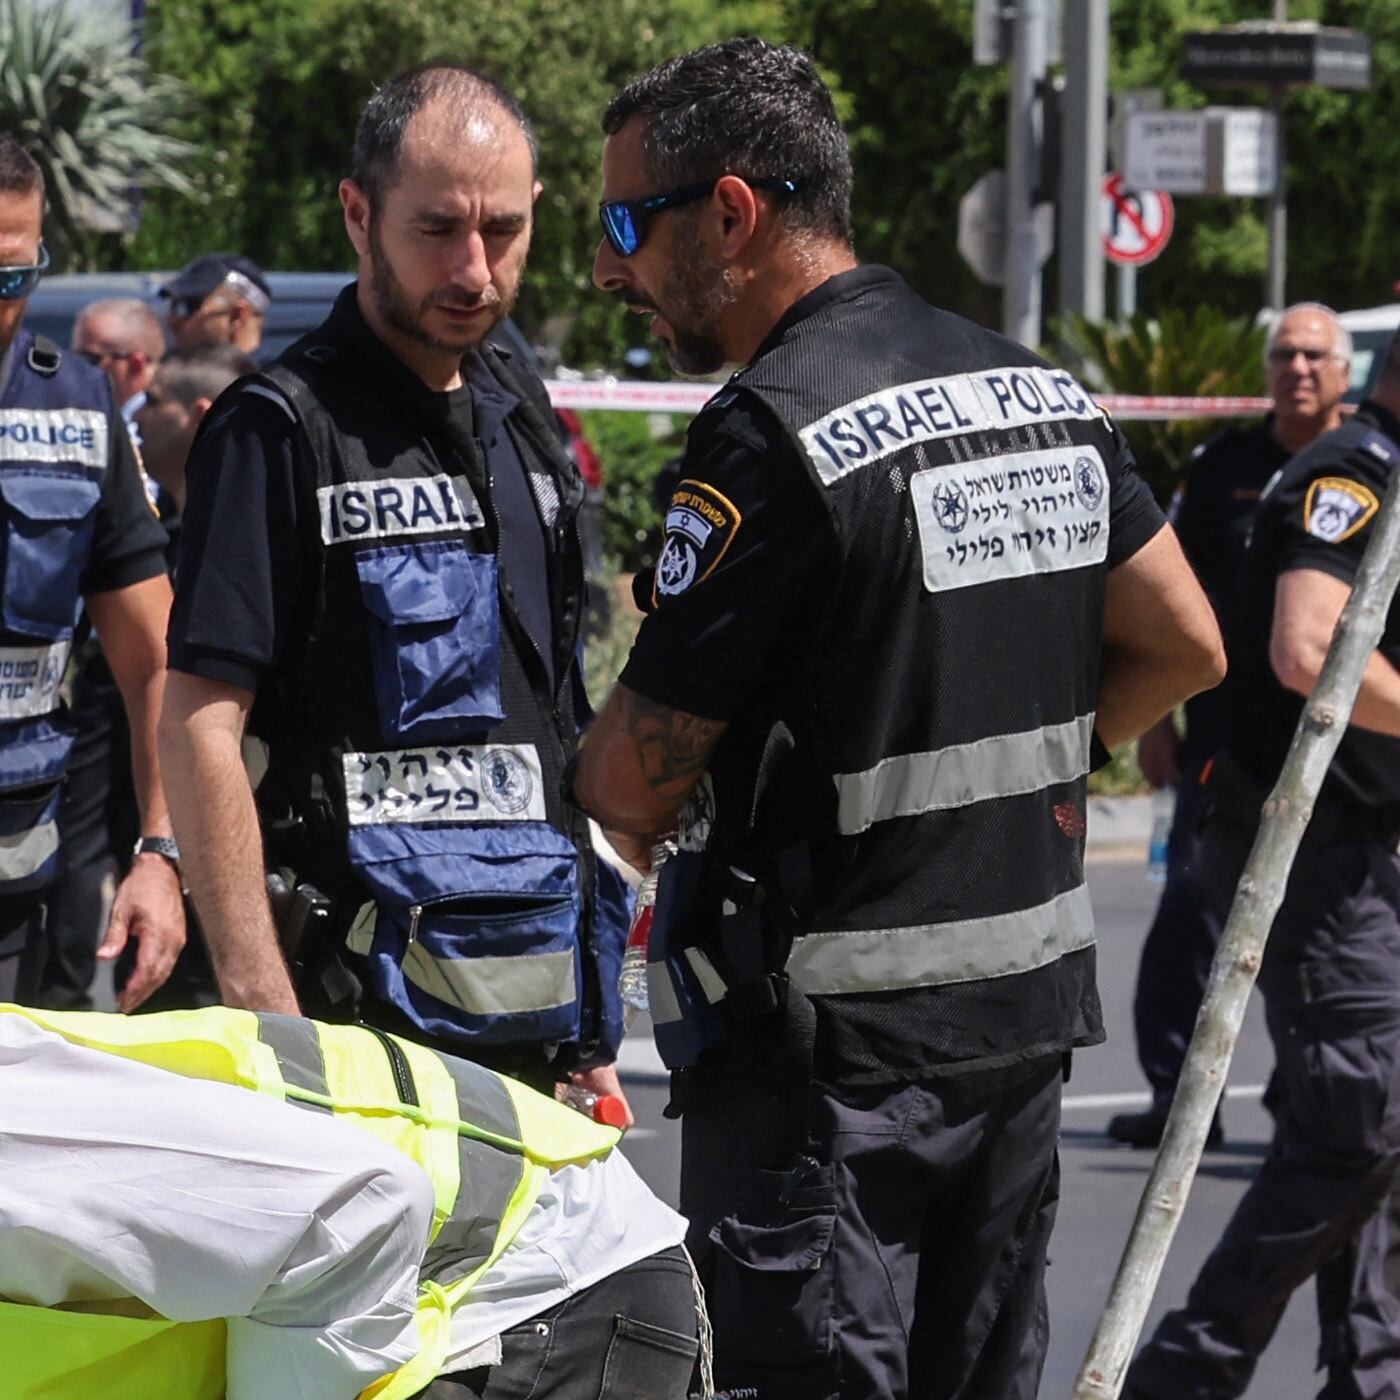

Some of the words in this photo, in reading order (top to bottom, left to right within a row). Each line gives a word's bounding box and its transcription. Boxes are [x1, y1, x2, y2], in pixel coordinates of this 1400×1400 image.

[814, 384, 974, 470] ISRAEL
[985, 373, 1086, 419] POLC
[1007, 463, 1071, 490] משטרת
[972, 499, 1013, 524] לילי
[1021, 490, 1075, 514] זיהוי
[946, 533, 1004, 567] פלילי
[1064, 520, 1101, 553] קצין
[358, 748, 475, 782] זיהוי
